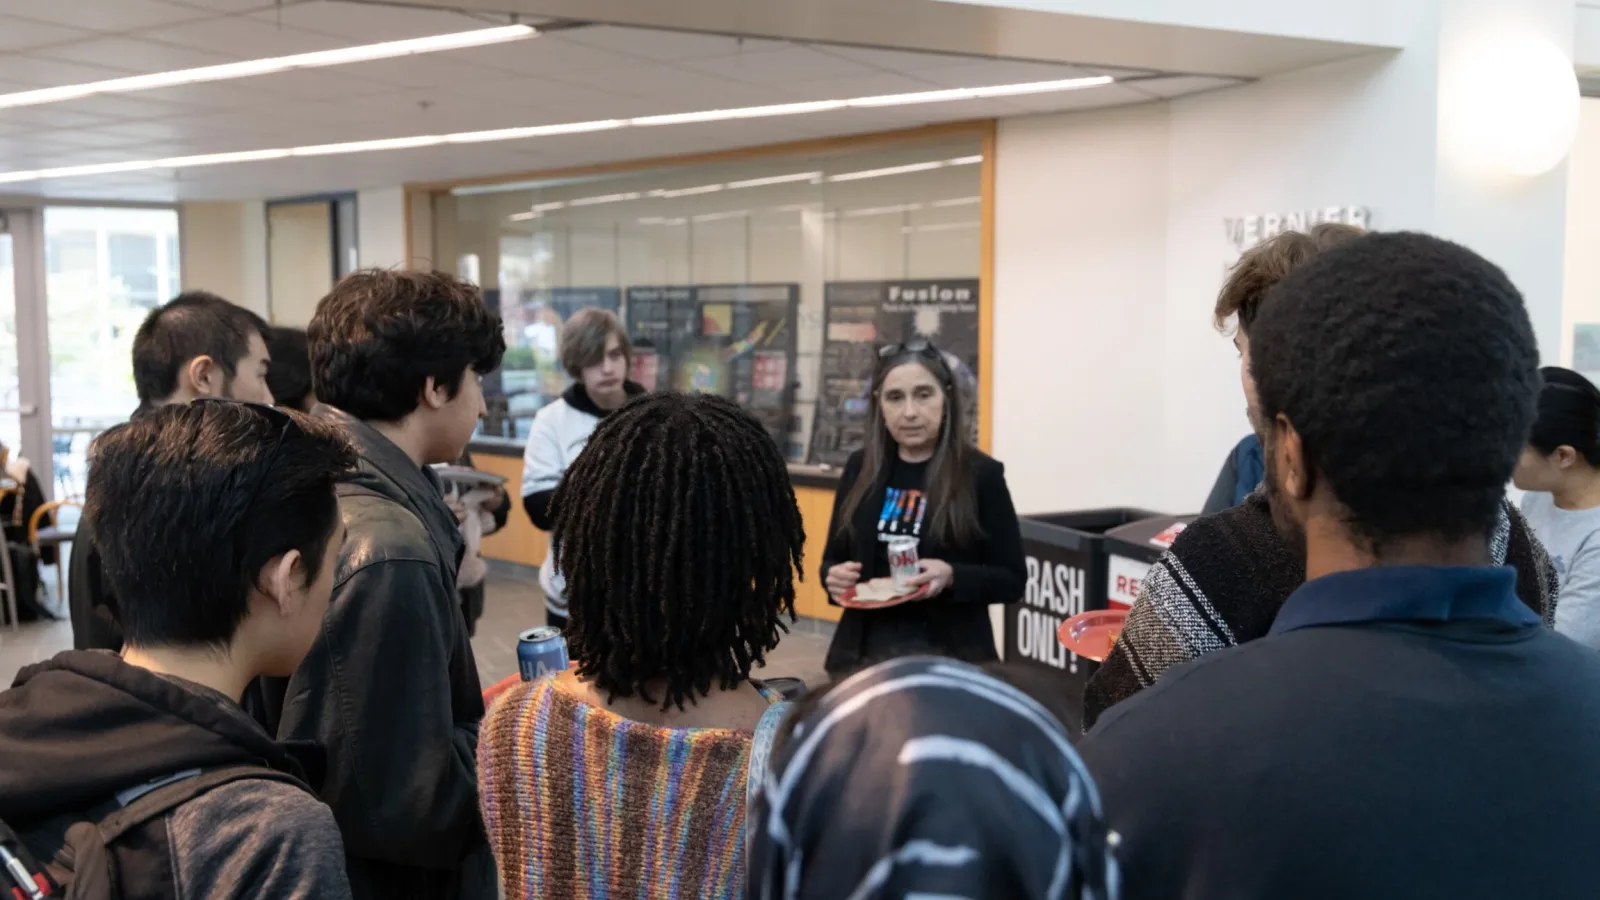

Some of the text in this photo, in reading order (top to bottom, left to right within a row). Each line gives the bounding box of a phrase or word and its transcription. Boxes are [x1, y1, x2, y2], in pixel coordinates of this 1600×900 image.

[1223, 205, 1371, 248] VERNIER
[887, 284, 971, 301] Fusion
[1024, 555, 1085, 616] RASH
[1116, 574, 1138, 597] RE
